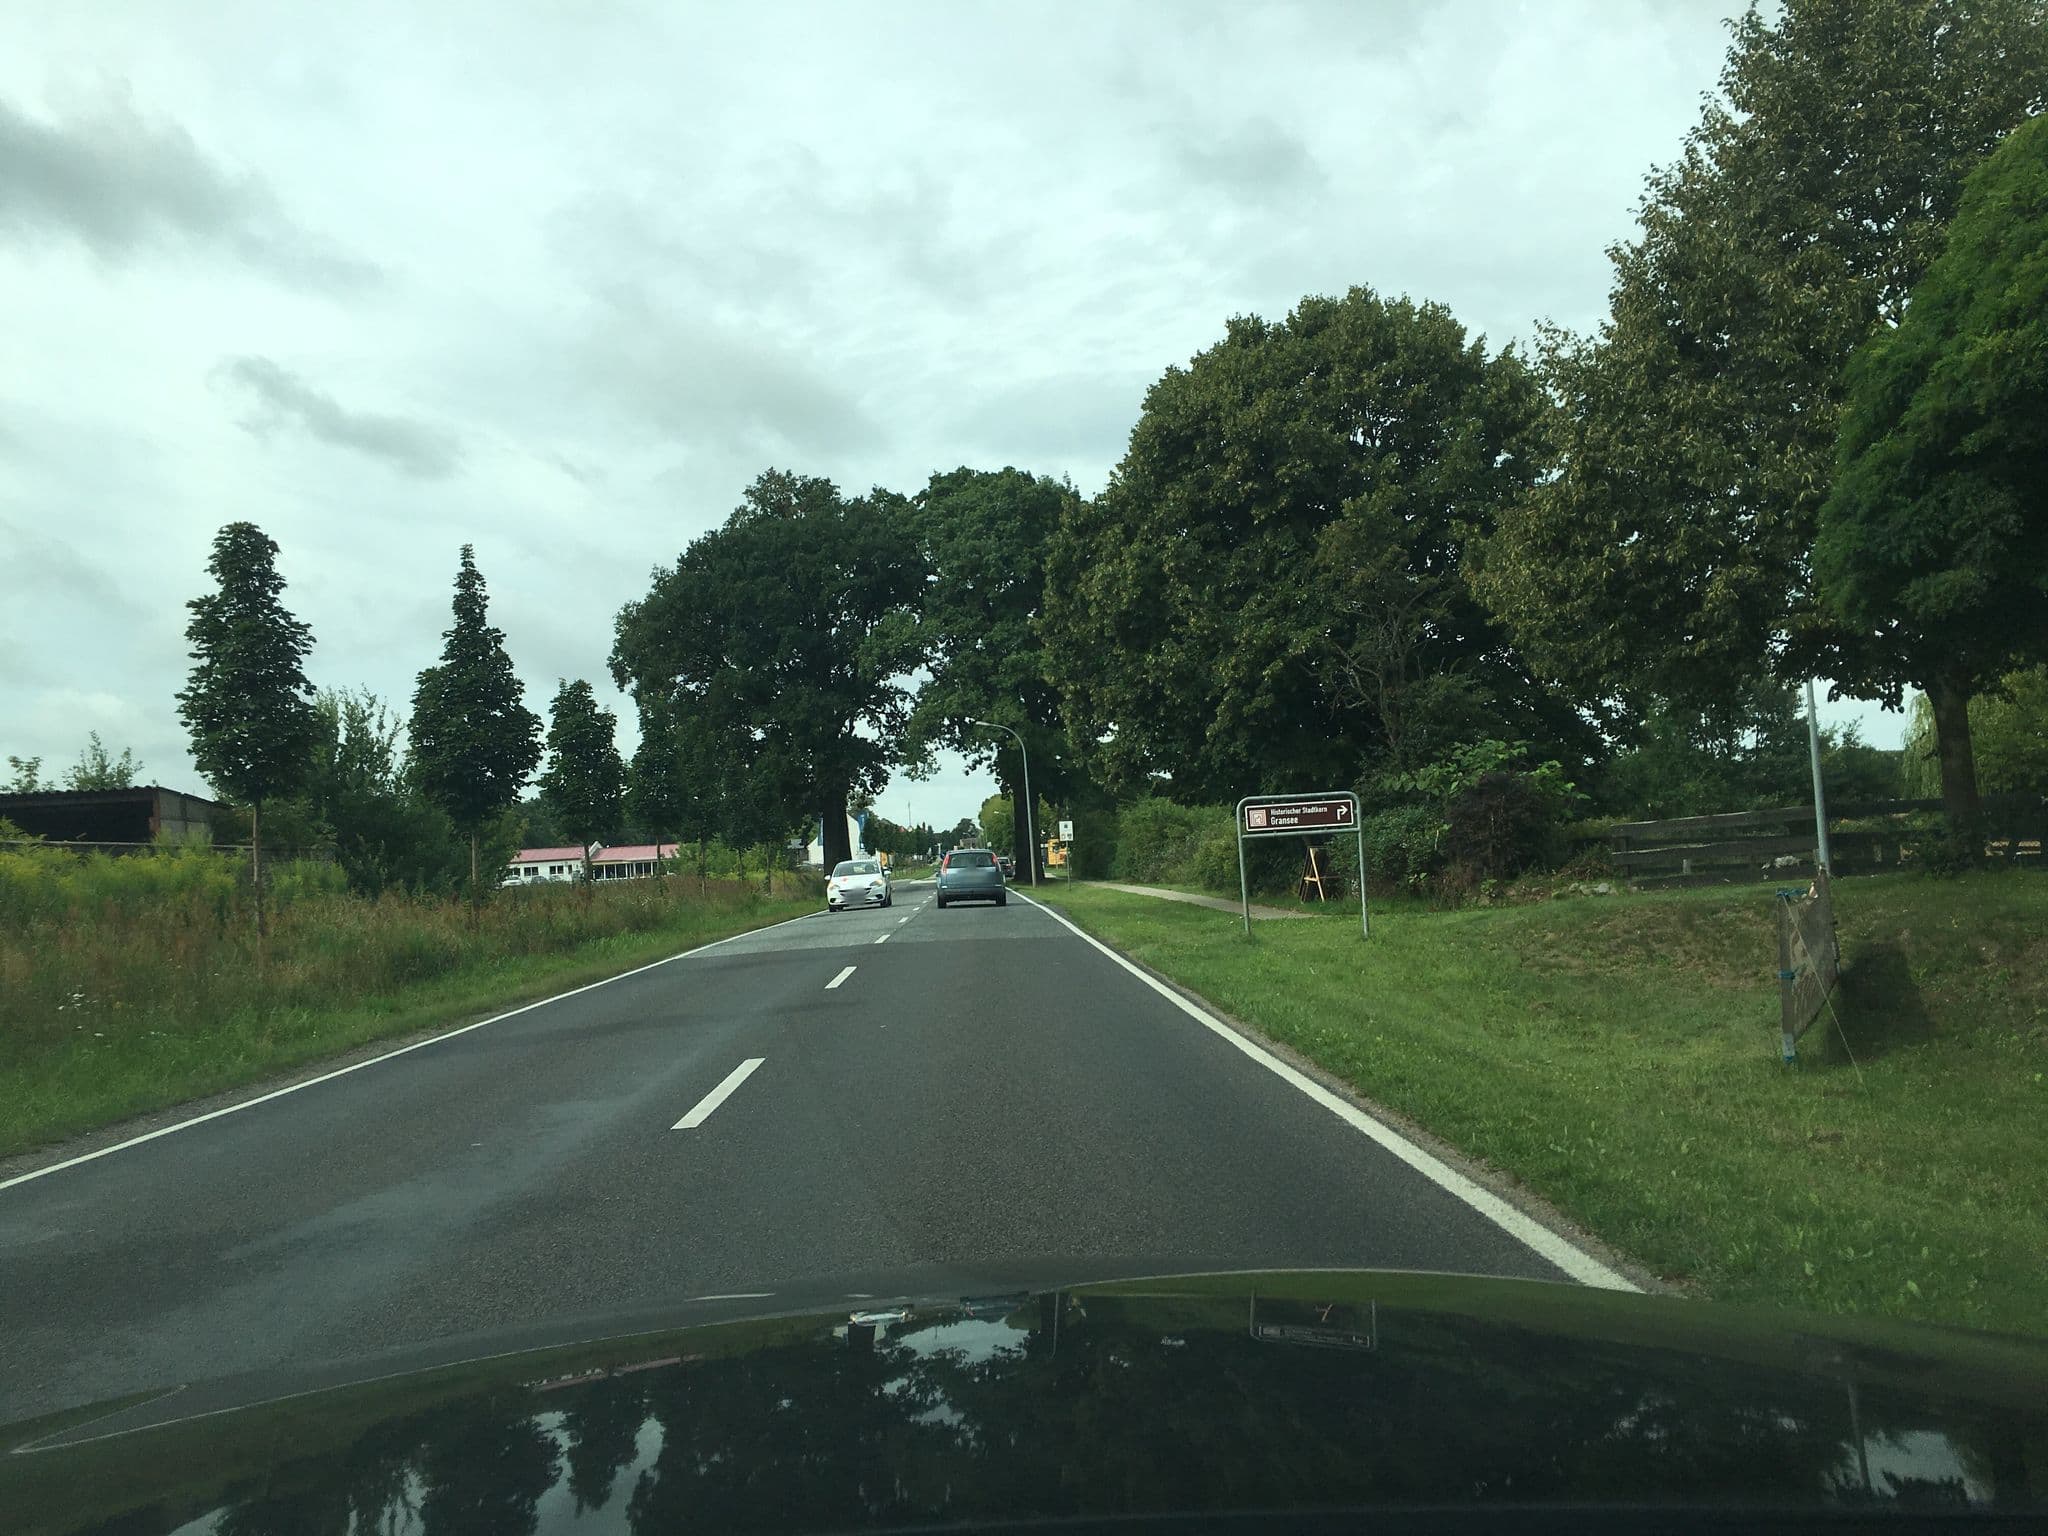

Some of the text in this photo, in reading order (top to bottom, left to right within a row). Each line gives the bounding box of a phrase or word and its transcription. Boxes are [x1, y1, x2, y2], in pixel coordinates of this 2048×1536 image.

[1270, 806, 1328, 816] Historischer Stadtkern
[1270, 816, 1298, 825] Gransee
